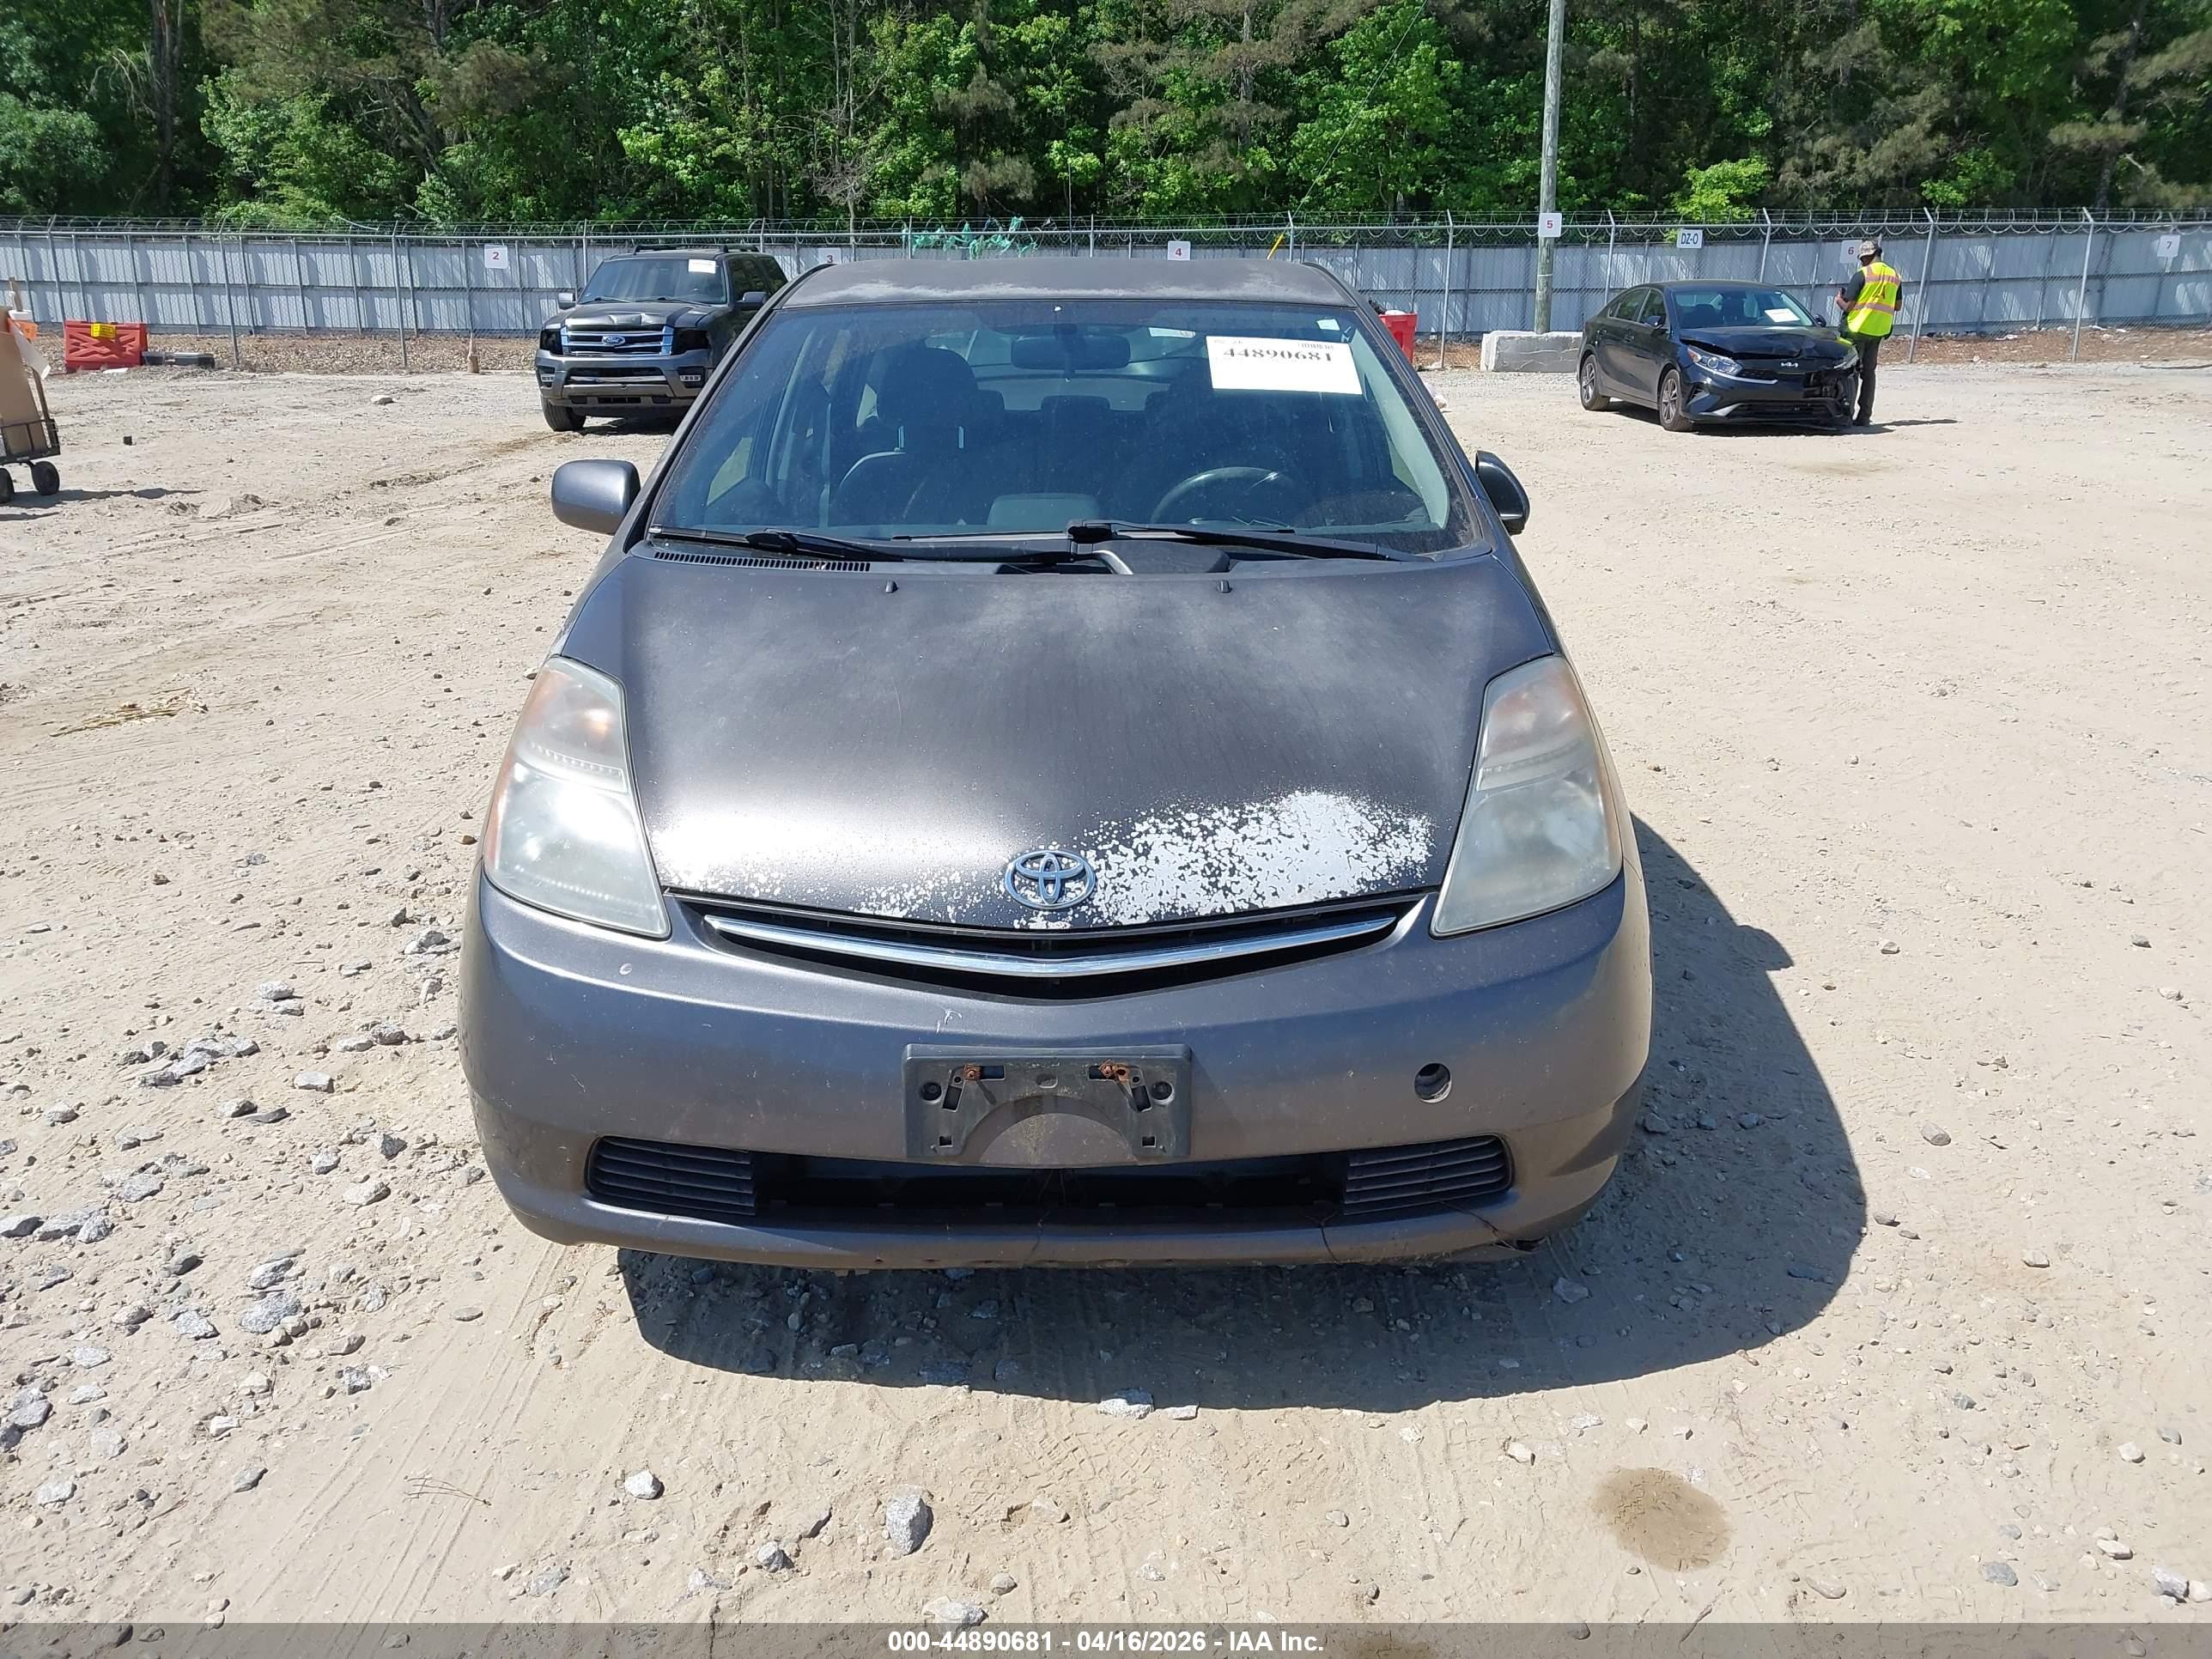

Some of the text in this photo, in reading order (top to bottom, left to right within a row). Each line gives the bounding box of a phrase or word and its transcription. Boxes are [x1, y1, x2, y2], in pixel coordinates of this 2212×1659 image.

[1547, 220, 1553, 228] 5
[1175, 248, 1182, 257] 4
[1848, 246, 1854, 255] 6
[493, 252, 500, 260] 2
[827, 255, 833, 264] 3
[1223, 348, 1332, 362] 44890681
